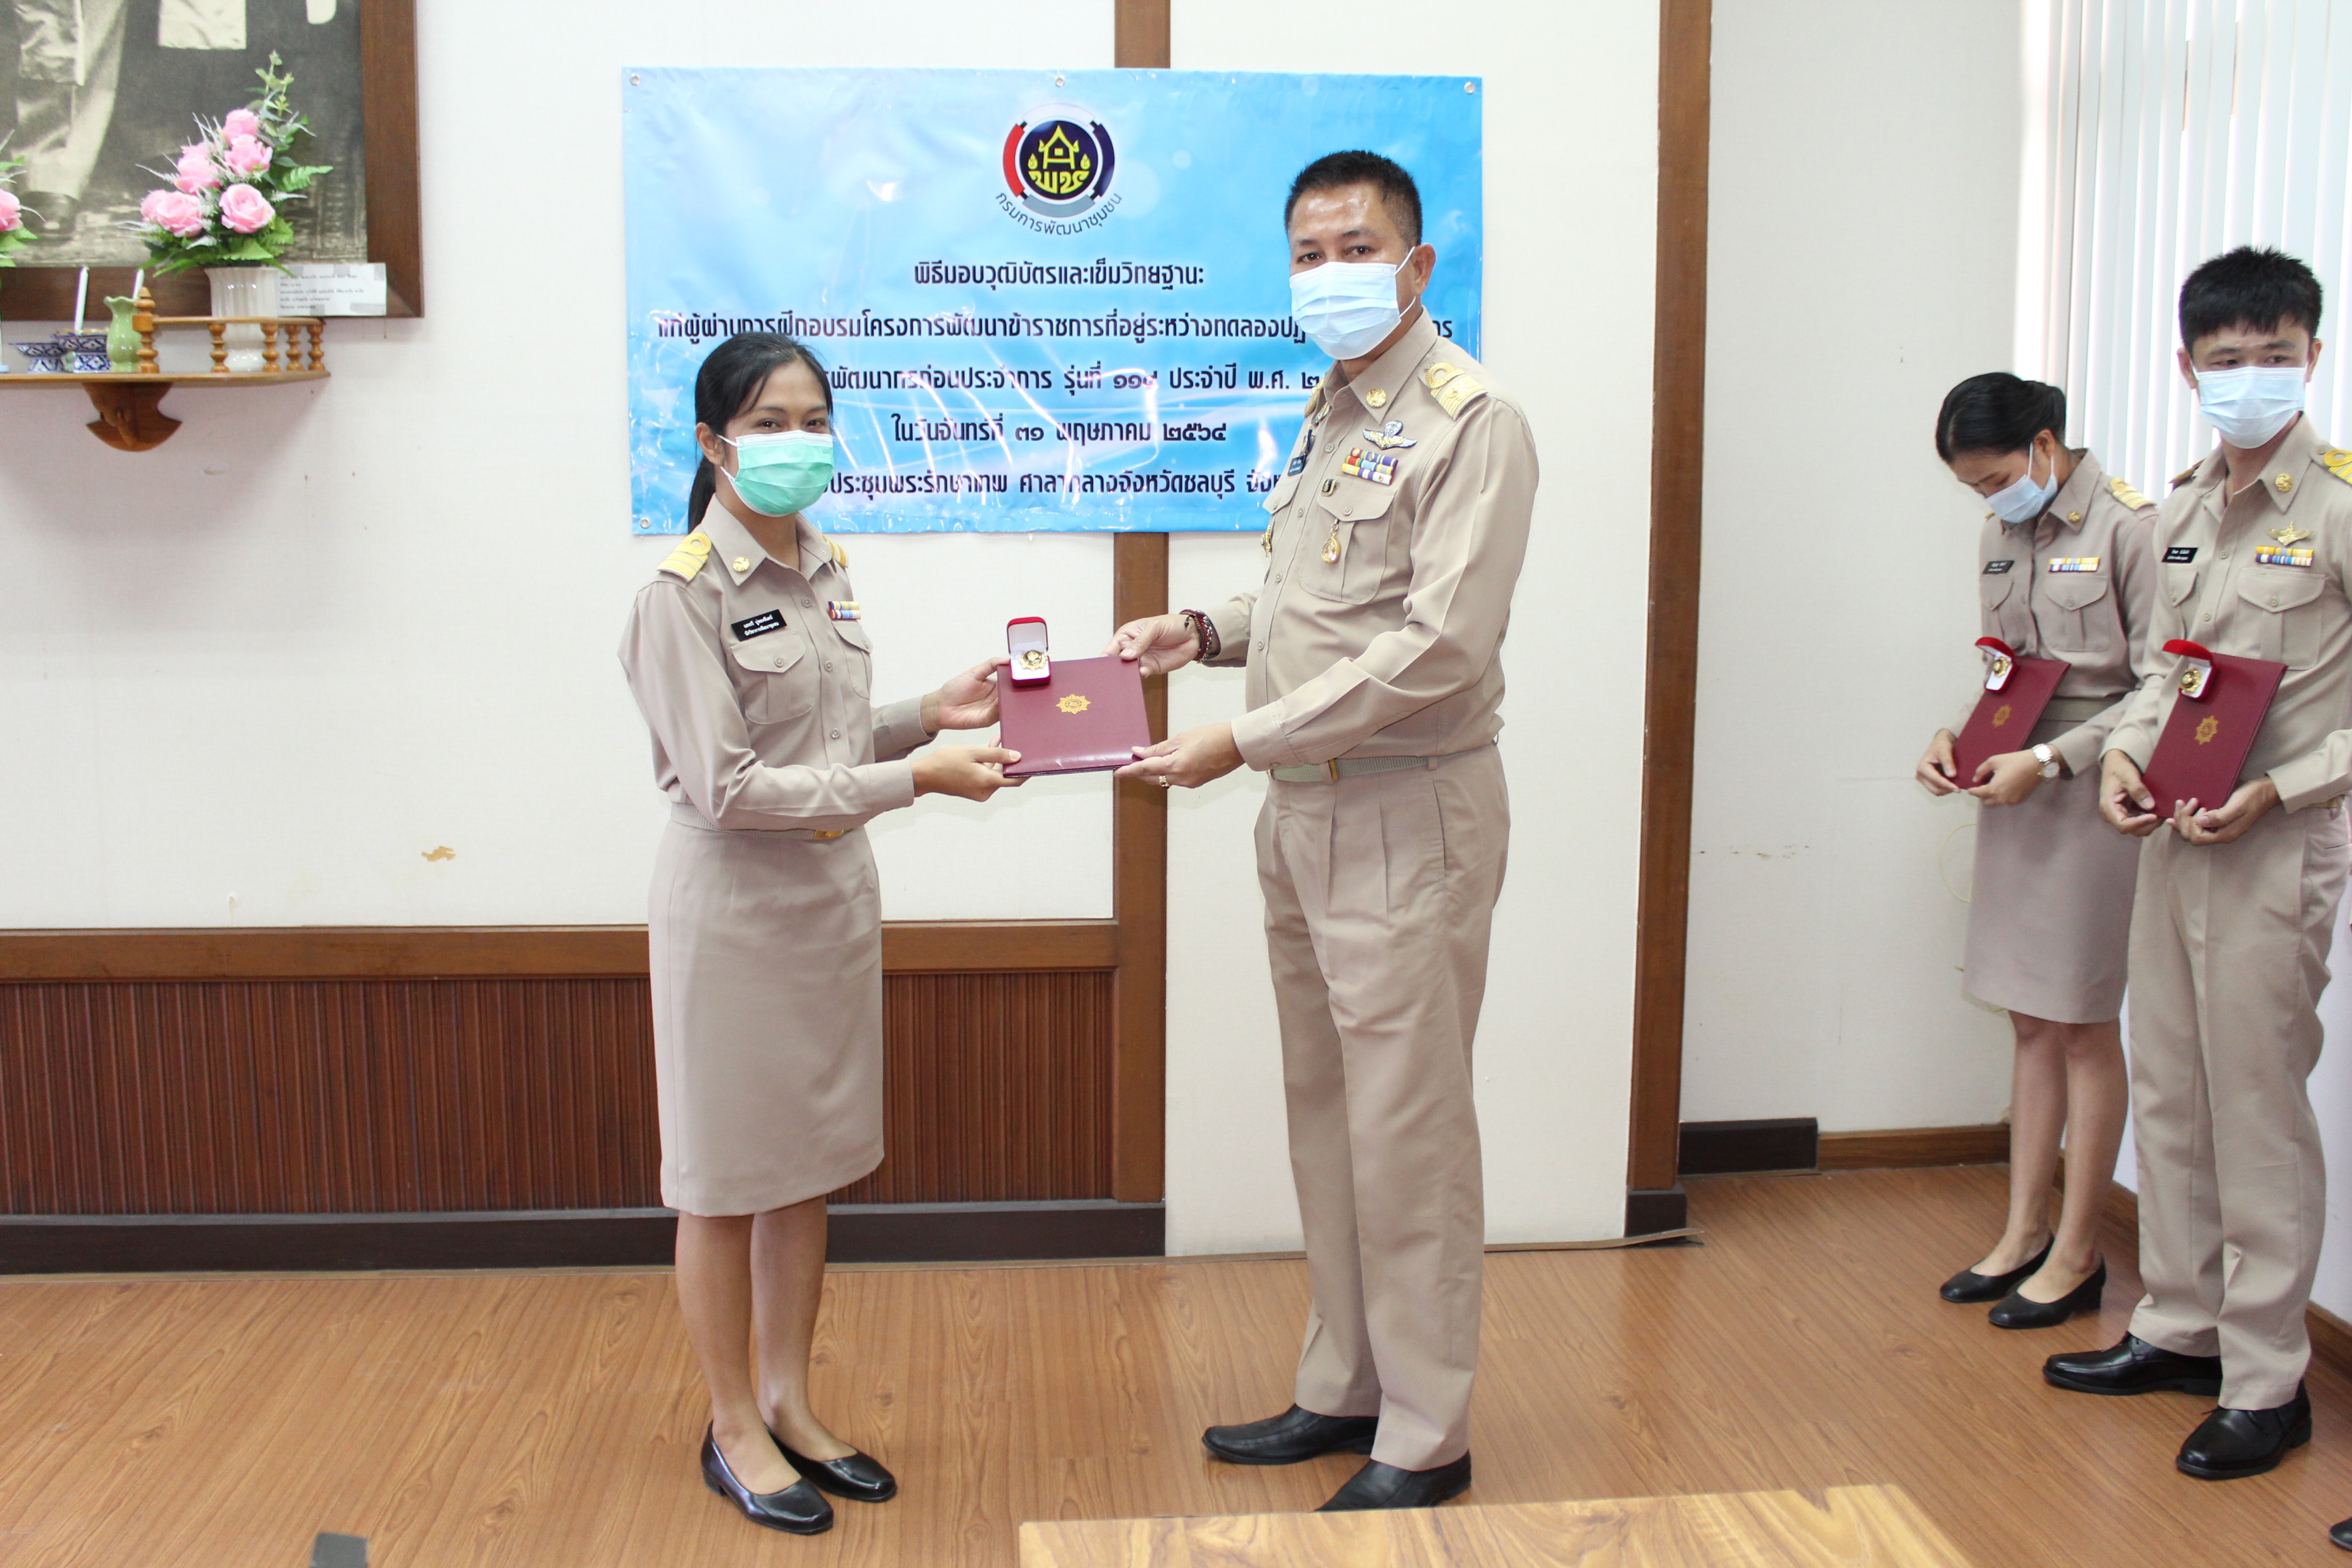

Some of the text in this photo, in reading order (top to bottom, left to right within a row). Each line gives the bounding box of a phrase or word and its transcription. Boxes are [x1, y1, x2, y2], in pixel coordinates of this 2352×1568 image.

[995, 192, 1122, 235] กรมการพัฒนาชุมชน
[914, 258, 1204, 291] พิธีมอบวุฒิบัตรและเข็มวิทยฐานะ
[824, 364, 1052, 390] พัฒนากรก่อนประจำการ
[1064, 361, 1102, 396] รุ่นที่
[1169, 363, 1237, 389] ประจำปี
[1248, 370, 1290, 389] พ.ศ.
[891, 412, 1226, 446] ในวันจันทร์ที่ ๓๑ พฤษภาคม ๒๕๖๔
[823, 470, 1007, 501] ประชุมพระรักษาเทพ
[1019, 469, 1235, 500] ศาลากลางจังหวัดชลบุรี
